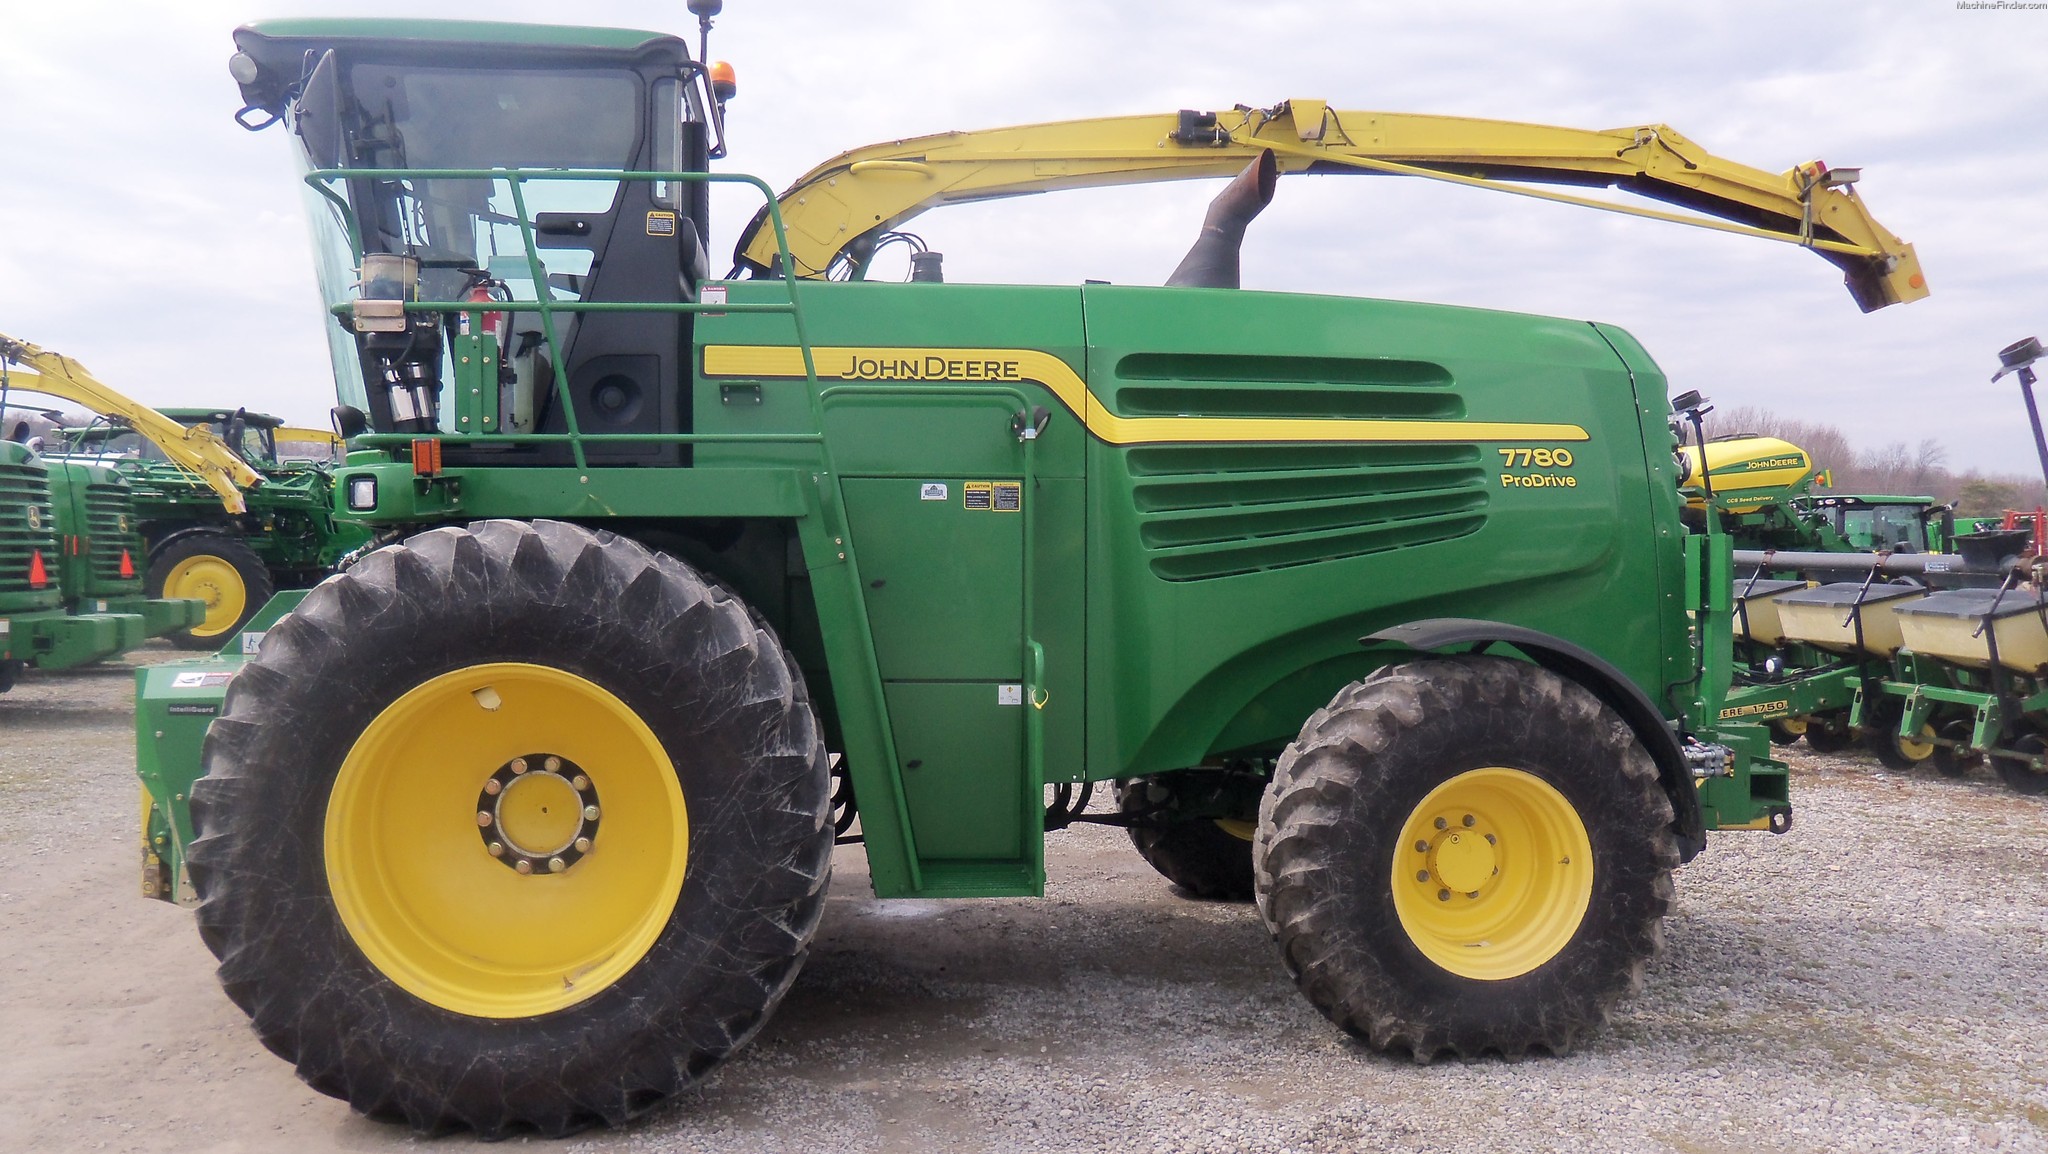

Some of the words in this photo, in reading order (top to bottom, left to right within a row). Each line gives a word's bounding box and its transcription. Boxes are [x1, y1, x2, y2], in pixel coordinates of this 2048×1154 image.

[841, 355, 919, 378] JOHN
[925, 356, 1019, 378] DEERE
[1498, 447, 1574, 468] 7780
[1746, 460, 1770, 470] JOHN
[1770, 458, 1798, 467] DEERE
[1500, 473, 1577, 488] ProDrive
[1718, 707, 1744, 719] ERE
[1752, 701, 1786, 713] 1750
